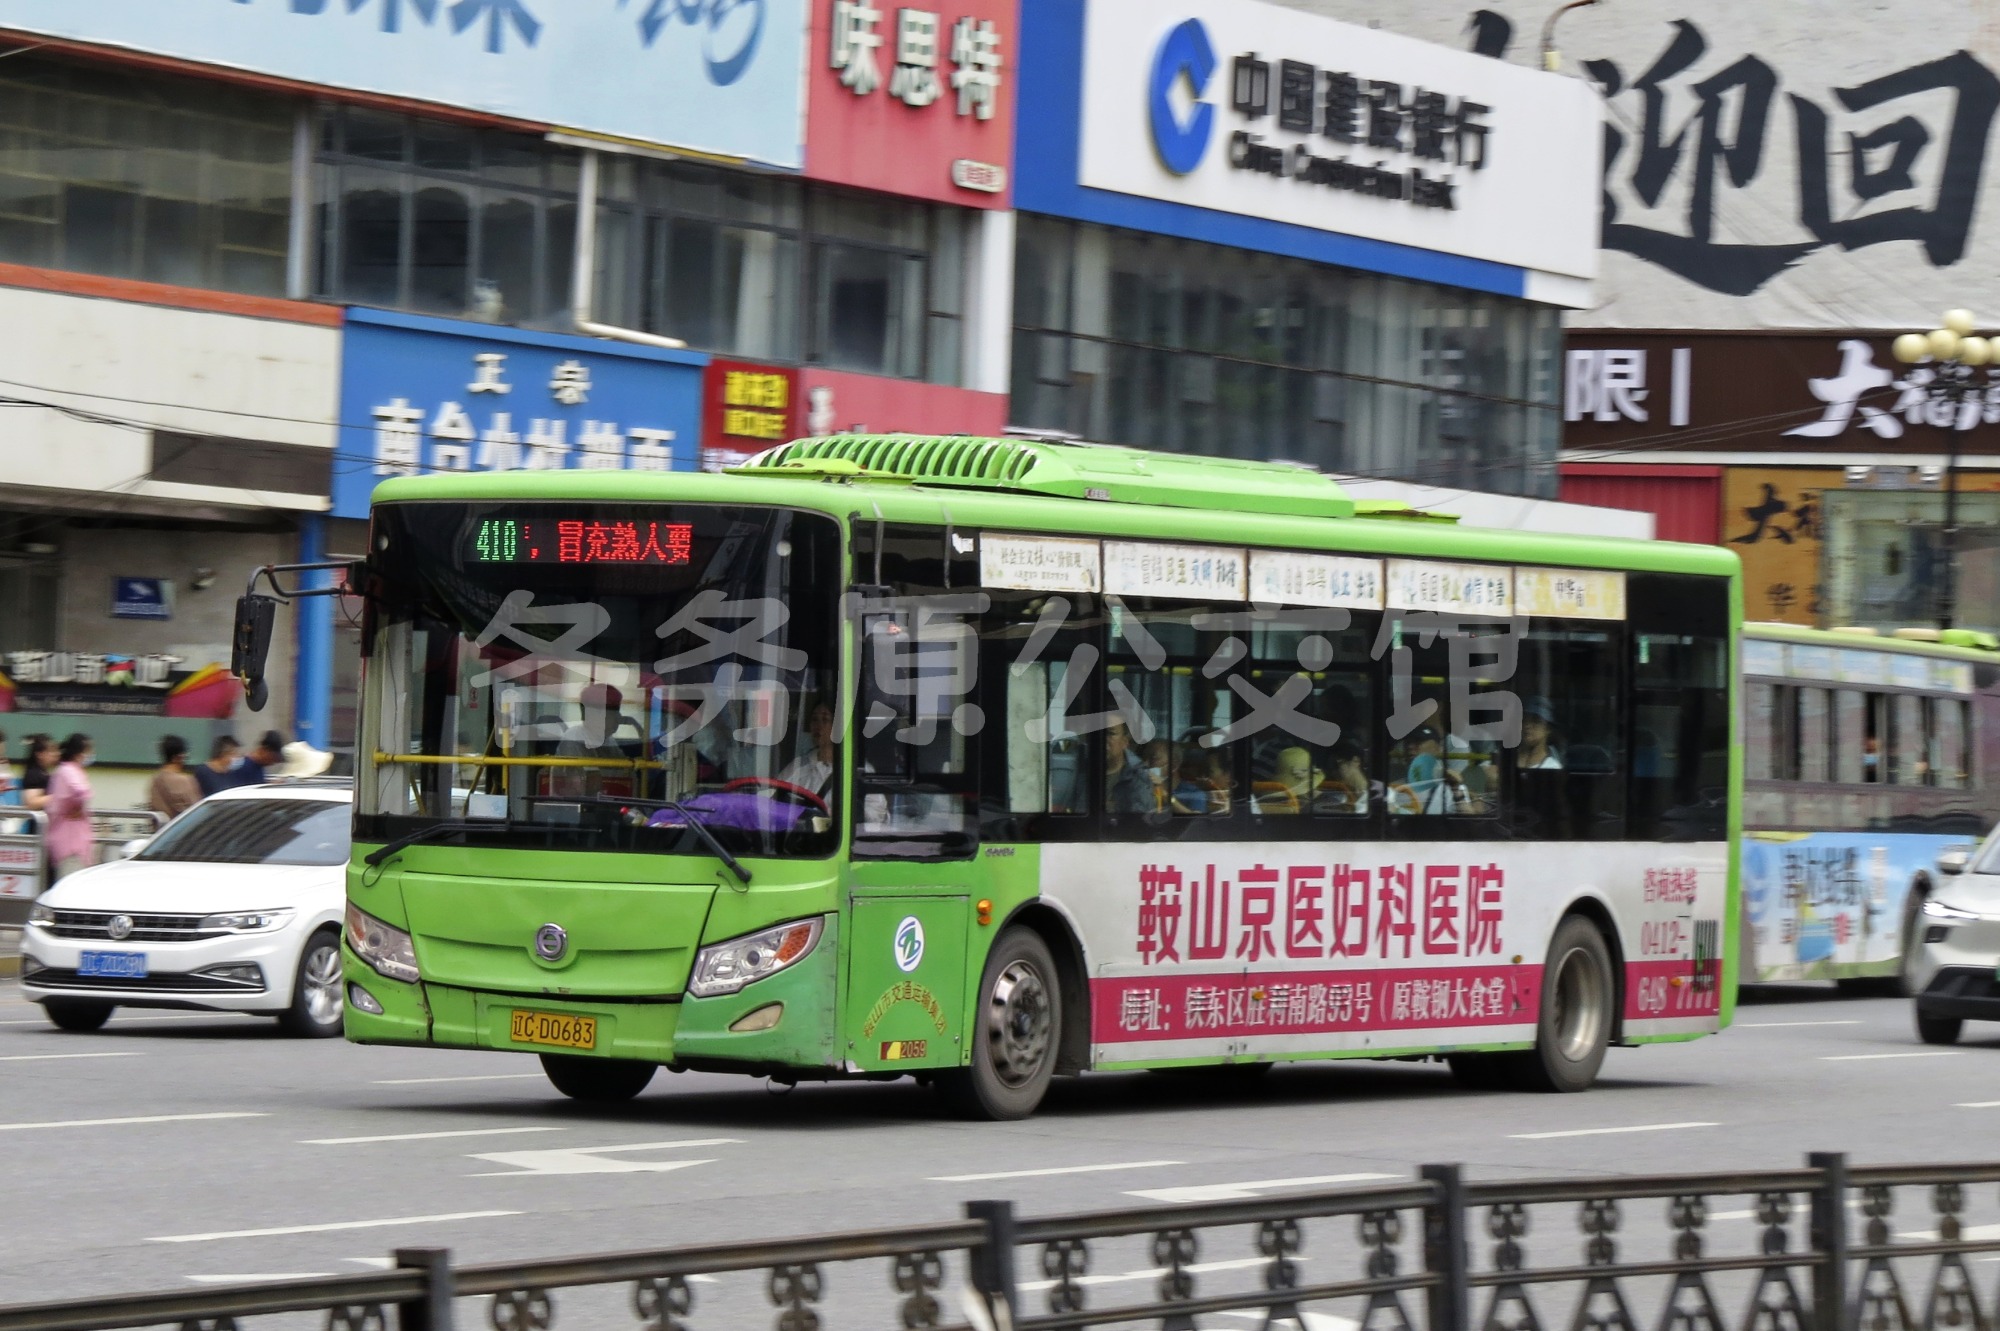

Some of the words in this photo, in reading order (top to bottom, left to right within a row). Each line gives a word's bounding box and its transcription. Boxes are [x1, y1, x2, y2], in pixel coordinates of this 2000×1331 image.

[830, 0, 1003, 120] 味思特
[1231, 51, 1496, 170] 中国建设银行
[1470, 10, 2000, 296] 迎回
[476, 520, 517, 561] 410
[1136, 862, 1505, 966] 鞍山京医妇科医院
[900, 1041, 927, 1058] 2059
